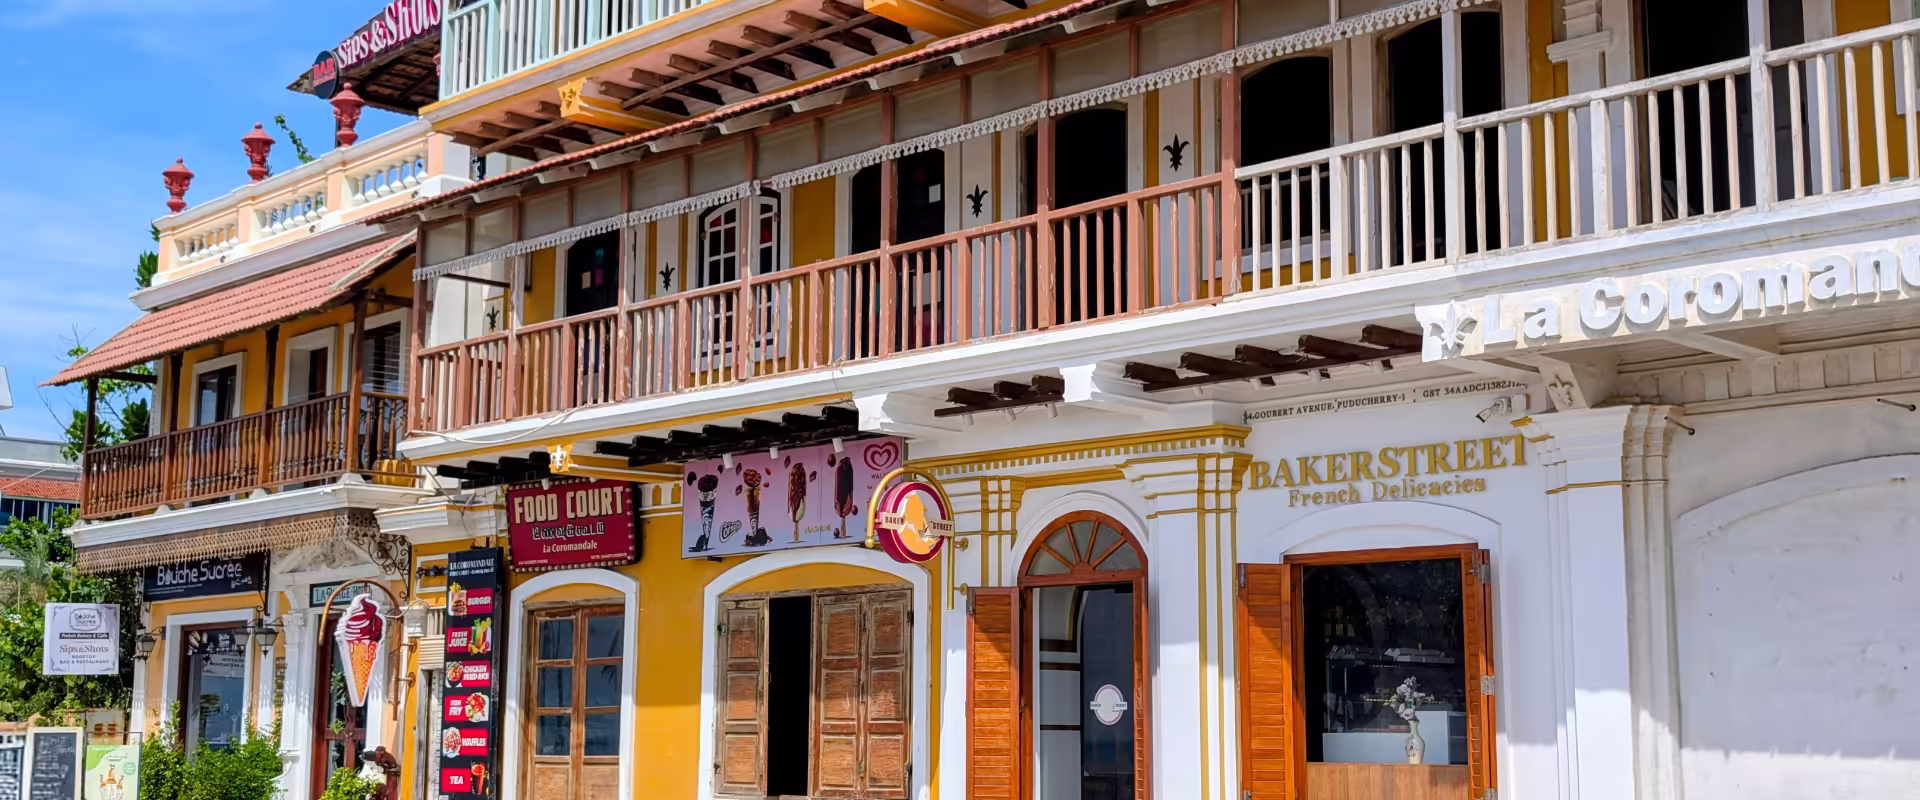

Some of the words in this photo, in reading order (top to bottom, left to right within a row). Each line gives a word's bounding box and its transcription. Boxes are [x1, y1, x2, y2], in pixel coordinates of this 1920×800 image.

[1483, 296, 1558, 344] La
[1423, 388, 1440, 398] GST
[1288, 483, 1360, 508] French
[1371, 476, 1487, 501] Delicacies
[514, 493, 559, 524] FOOD
[566, 486, 624, 519] COURT
[932, 522, 953, 531] STREET
[543, 544, 551, 553] La
[552, 540, 598, 553] Coromandale
[316, 588, 326, 601] LA
[468, 596, 491, 605] BURGER
[449, 637, 468, 647] JUICE
[464, 665, 487, 673] CHICKEN
[478, 672, 489, 680] RICE
[449, 706, 463, 716] FRY
[461, 738, 486, 746] WAFFLES
[449, 776, 464, 784] TEA
